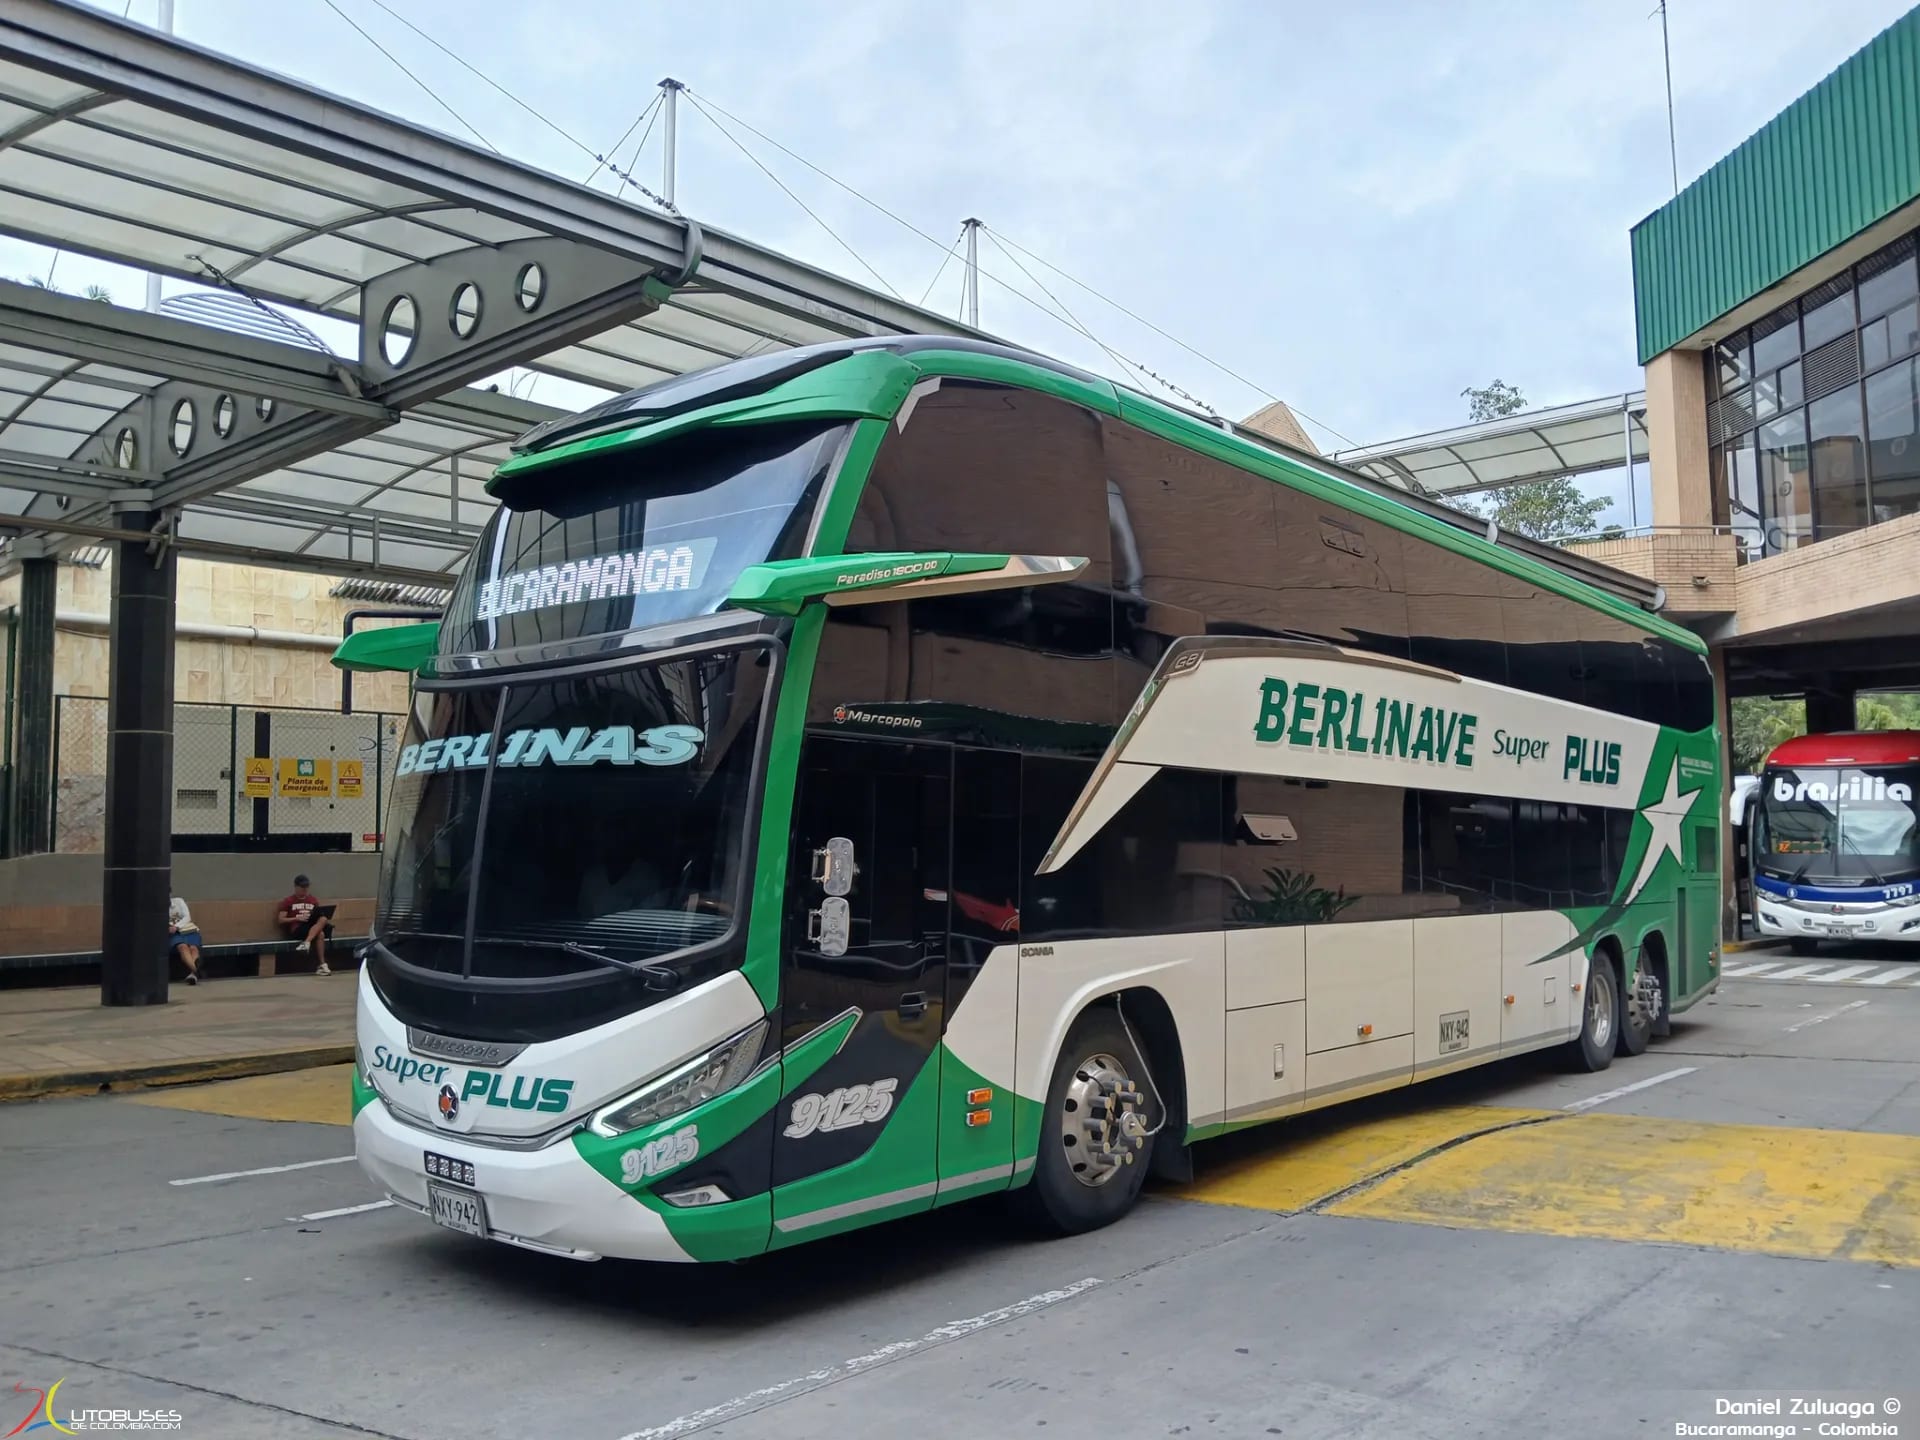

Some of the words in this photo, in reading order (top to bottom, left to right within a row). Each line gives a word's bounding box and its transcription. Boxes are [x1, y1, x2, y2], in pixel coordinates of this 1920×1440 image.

[477, 546, 695, 620] BUCARAMANGA
[837, 568, 891, 586] Paradiso
[892, 563, 923, 576] 1800
[924, 560, 938, 571] DD
[848, 709, 922, 728] Marcopolo
[1253, 675, 1478, 769] BERLINAVE
[396, 723, 705, 777] BERLINAS
[1492, 729, 1550, 762] Super
[1563, 735, 1623, 786] PLUS
[282, 784, 328, 792] Emergencia
[1773, 776, 1912, 801] brasilia
[1021, 946, 1054, 958] SCANIA
[372, 1045, 449, 1084] Super
[460, 1070, 575, 1113] PLUS
[783, 1077, 899, 1139] 9125
[621, 1123, 699, 1184] 9125
